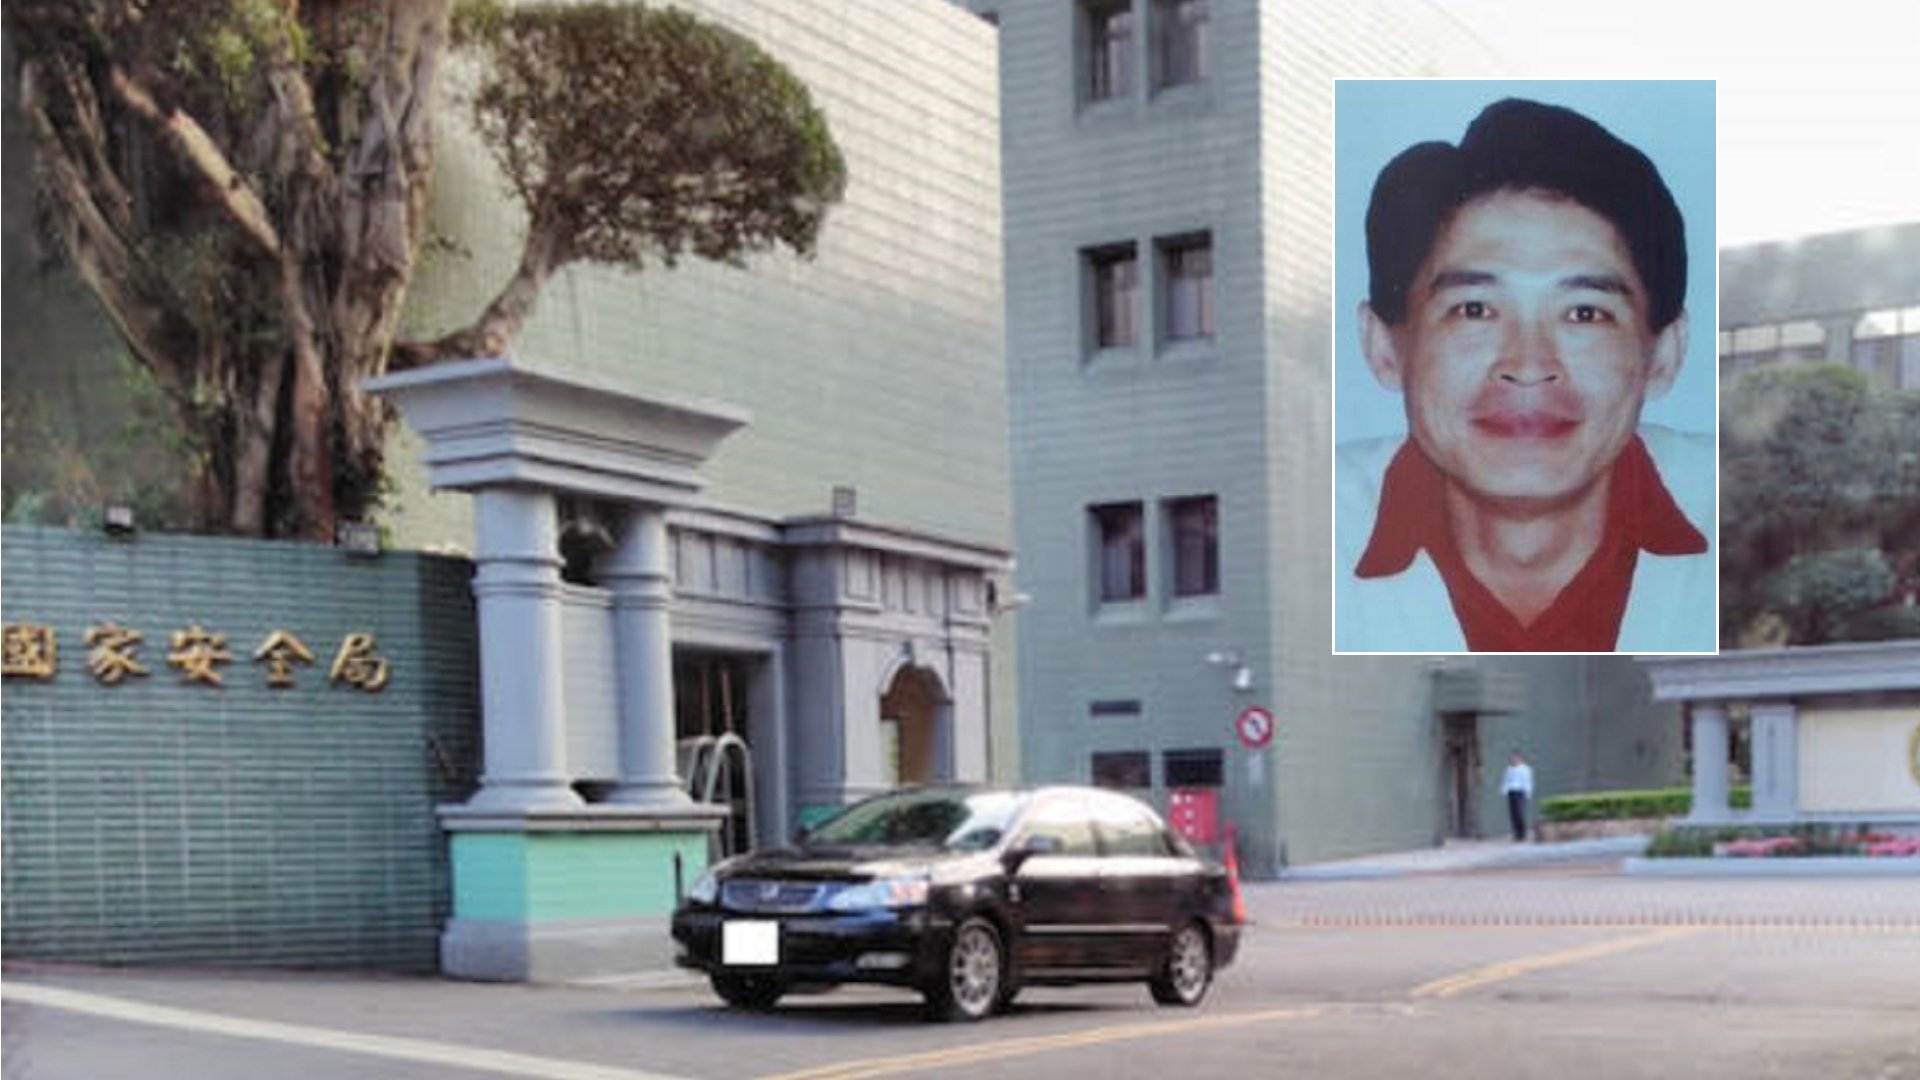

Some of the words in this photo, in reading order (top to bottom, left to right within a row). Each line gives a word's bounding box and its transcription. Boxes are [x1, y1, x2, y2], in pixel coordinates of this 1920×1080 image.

[1, 623, 391, 692] 國家安全局
